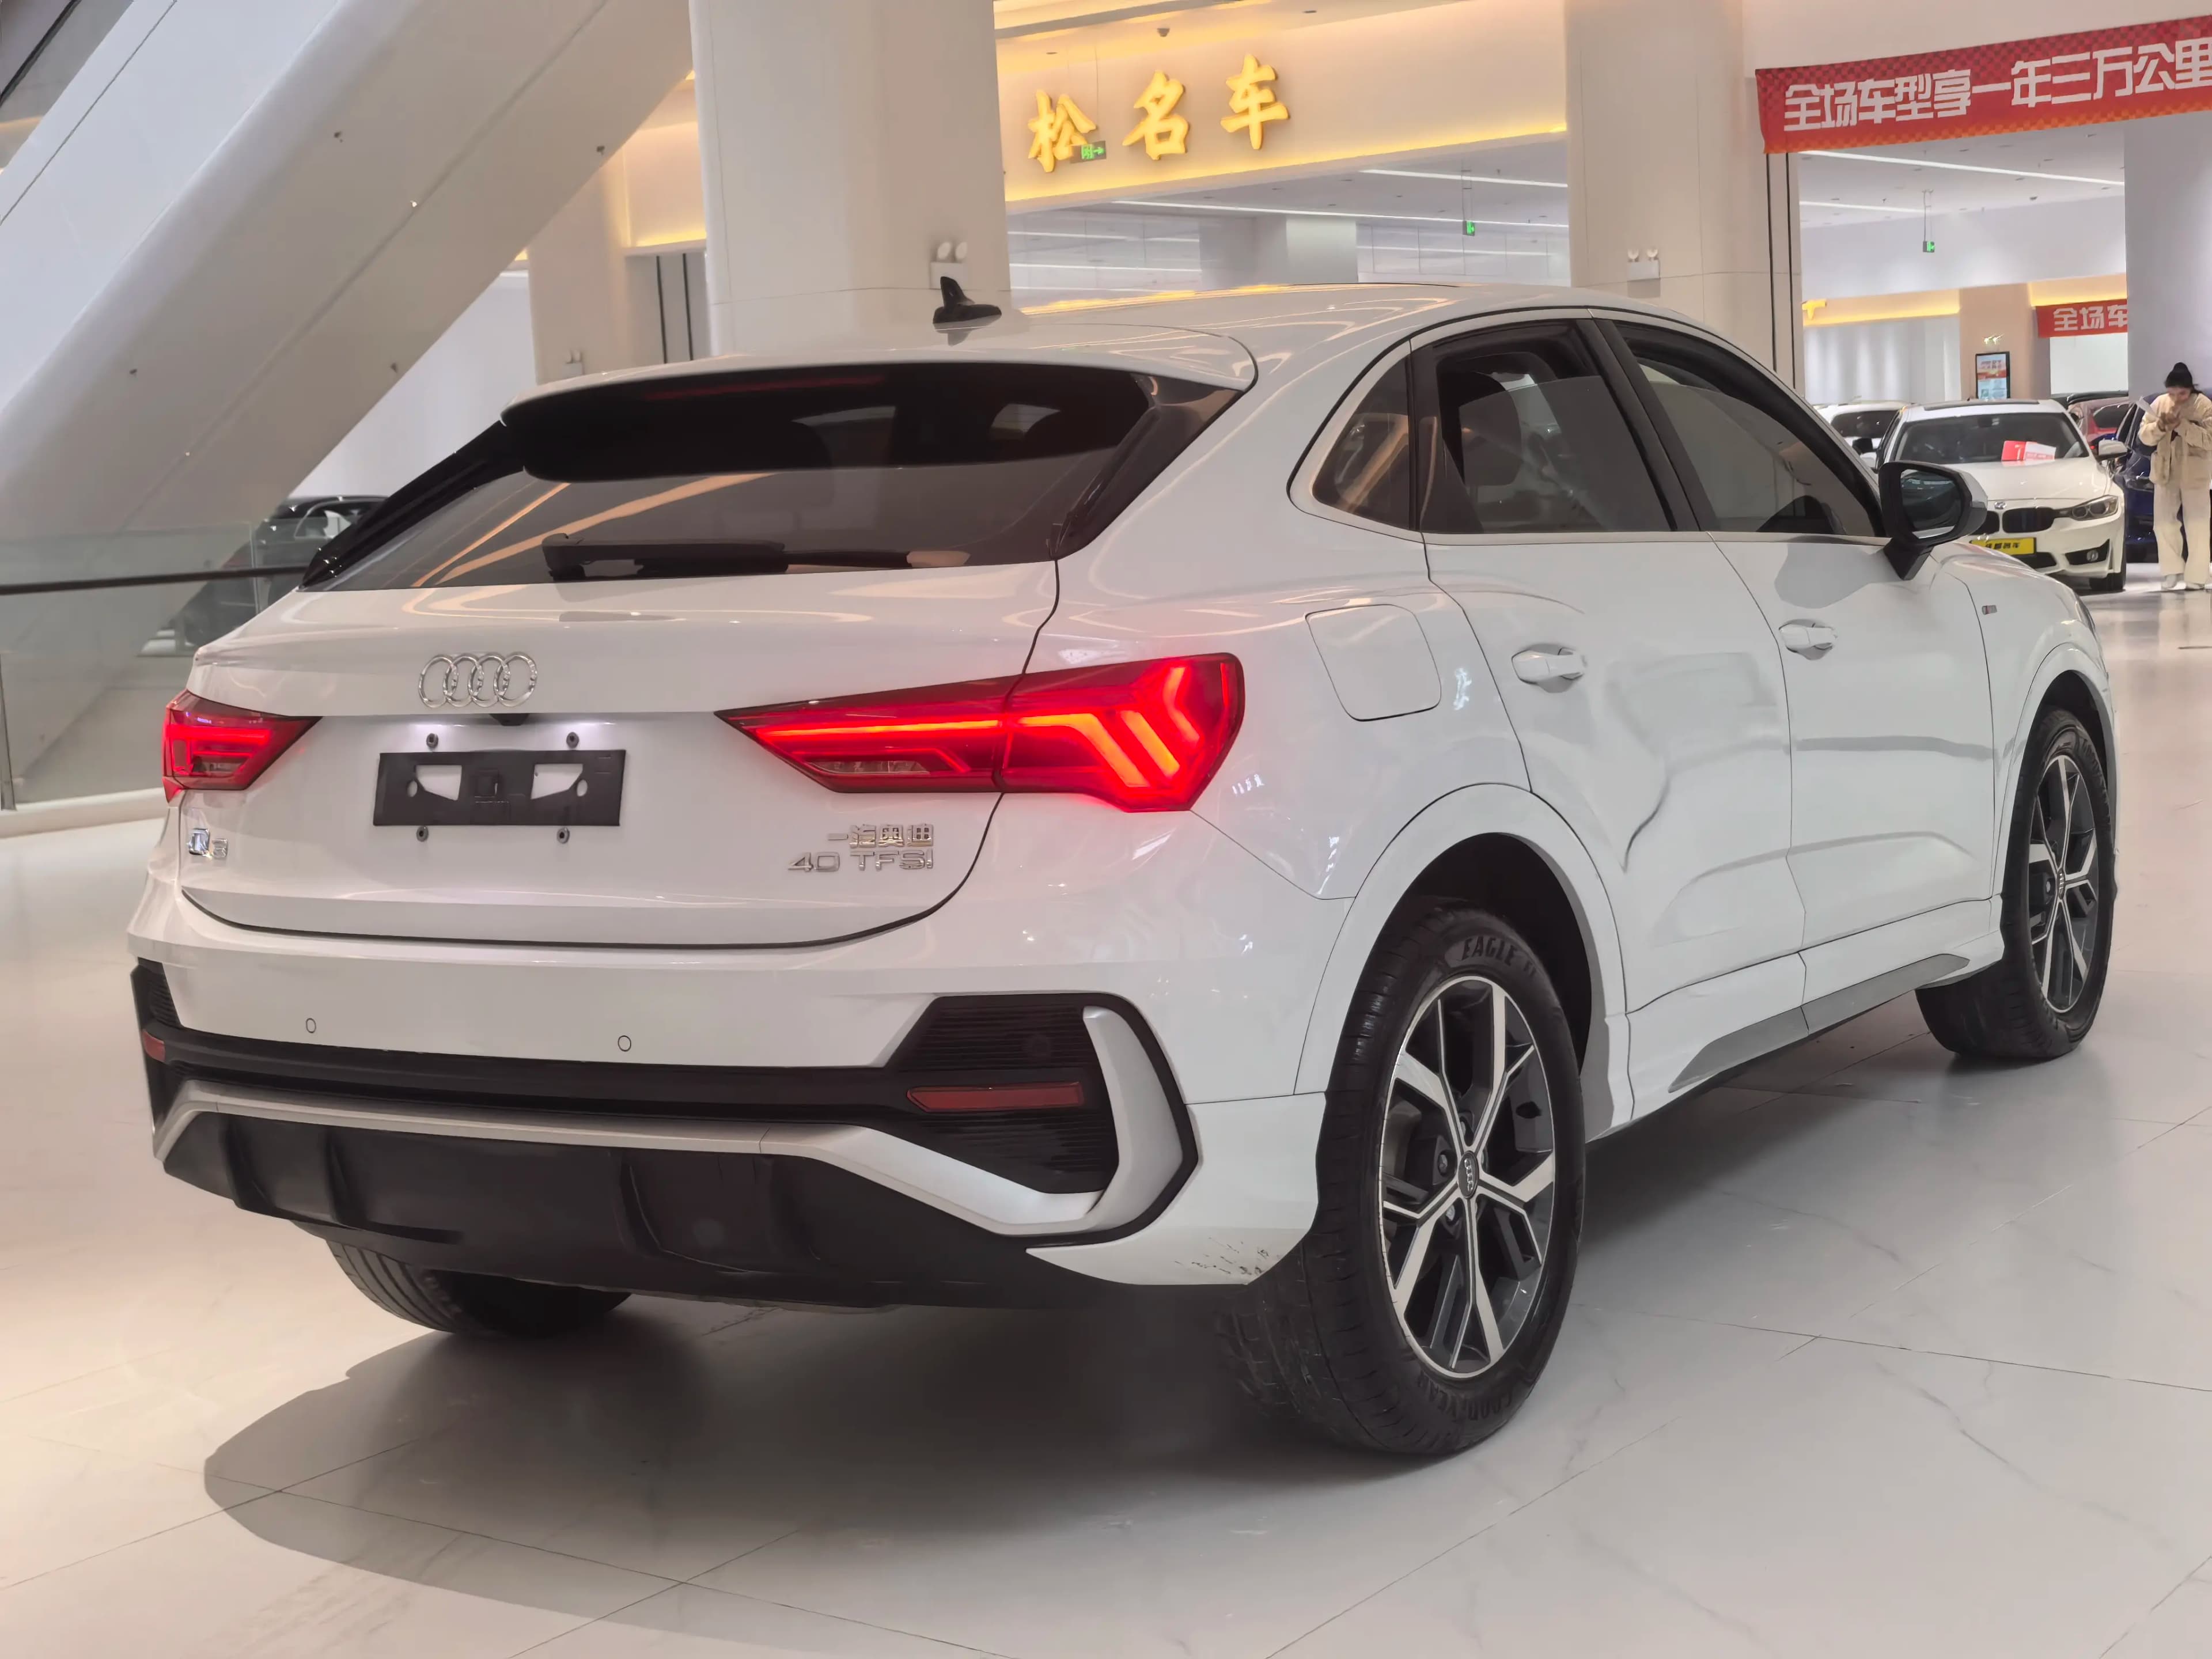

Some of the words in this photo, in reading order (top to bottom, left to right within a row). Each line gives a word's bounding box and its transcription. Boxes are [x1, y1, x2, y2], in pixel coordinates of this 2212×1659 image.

[1783, 37, 2212, 131] 全场车型享一年三万公里
[2054, 304, 2128, 332] 全场车
[788, 851, 840, 872] 40
[850, 848, 933, 872] TFSI
[1460, 935, 1517, 967] EAGLE
